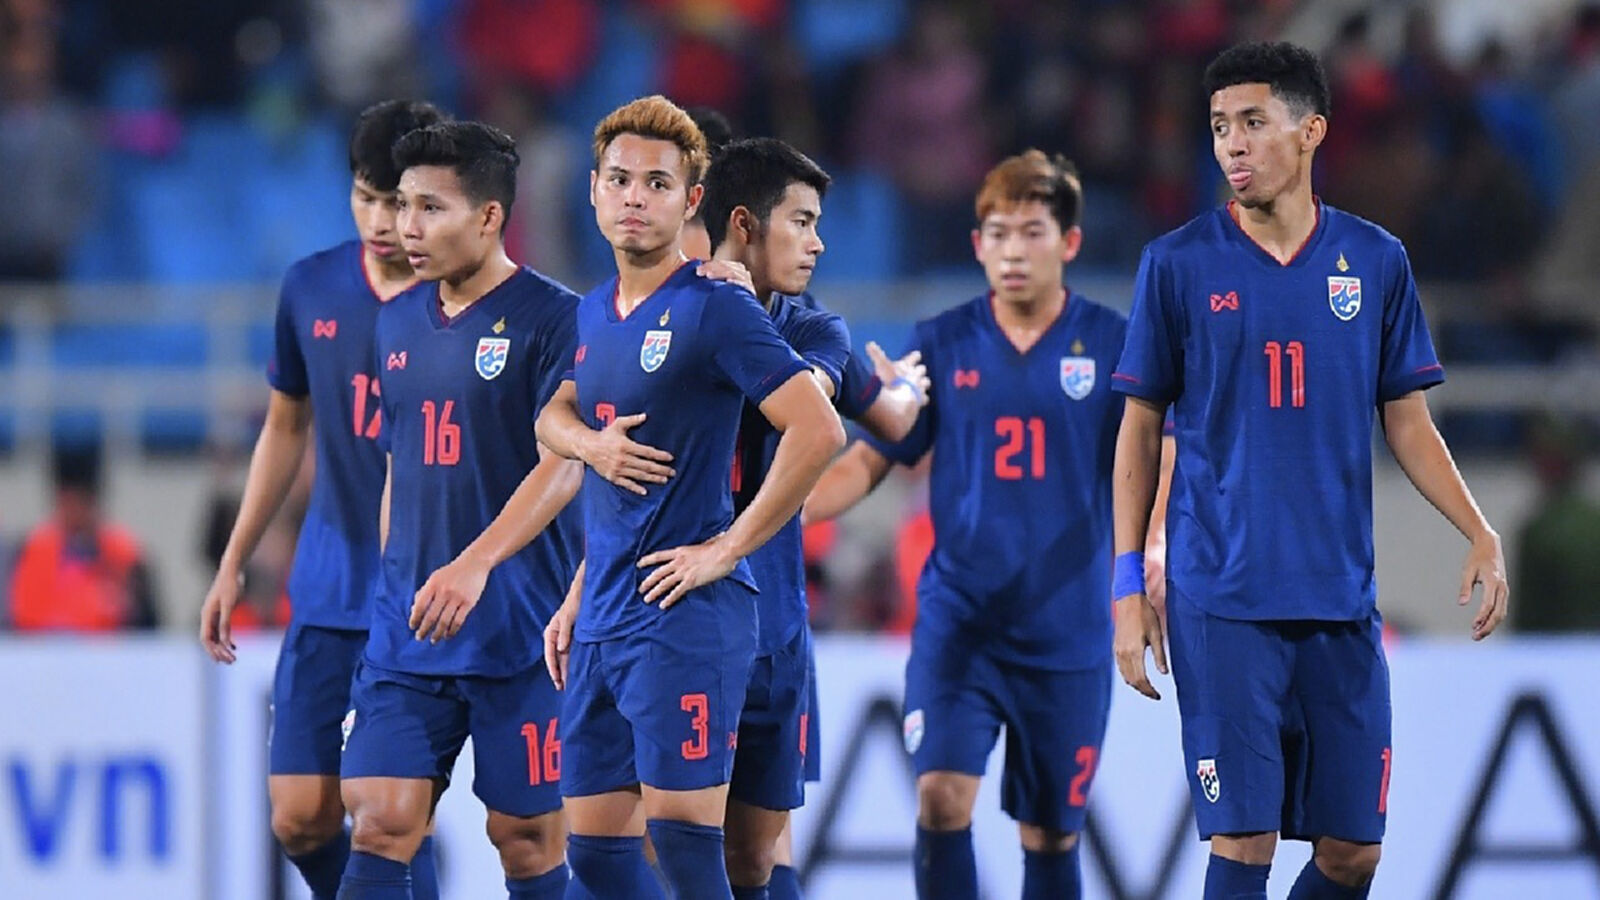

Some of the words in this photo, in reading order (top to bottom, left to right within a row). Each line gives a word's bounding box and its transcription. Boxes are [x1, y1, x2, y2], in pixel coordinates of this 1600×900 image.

[1264, 341, 1305, 408] 11
[421, 400, 461, 465] 16
[994, 416, 1046, 479] 21
[520, 717, 562, 786] 16
[679, 693, 709, 760] 3
[6, 752, 173, 868] vn
